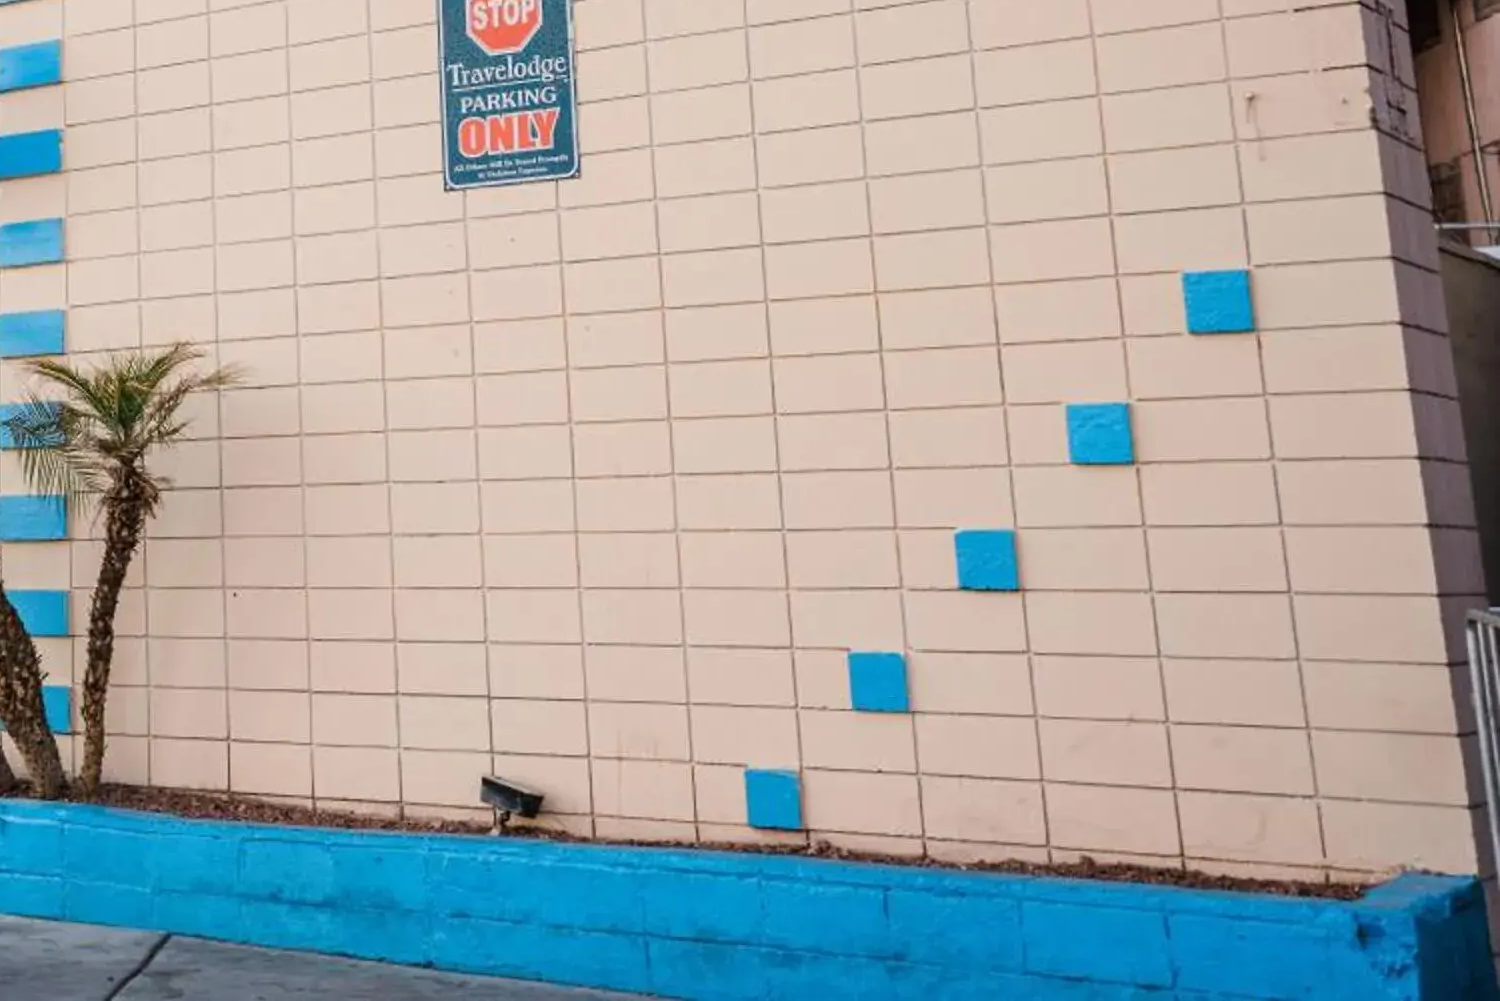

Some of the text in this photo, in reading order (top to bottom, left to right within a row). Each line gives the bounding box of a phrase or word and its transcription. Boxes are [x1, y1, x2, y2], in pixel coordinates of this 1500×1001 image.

[447, 55, 567, 86] Travelodge
[460, 87, 558, 114] PARKING
[458, 107, 561, 158] ONLY
